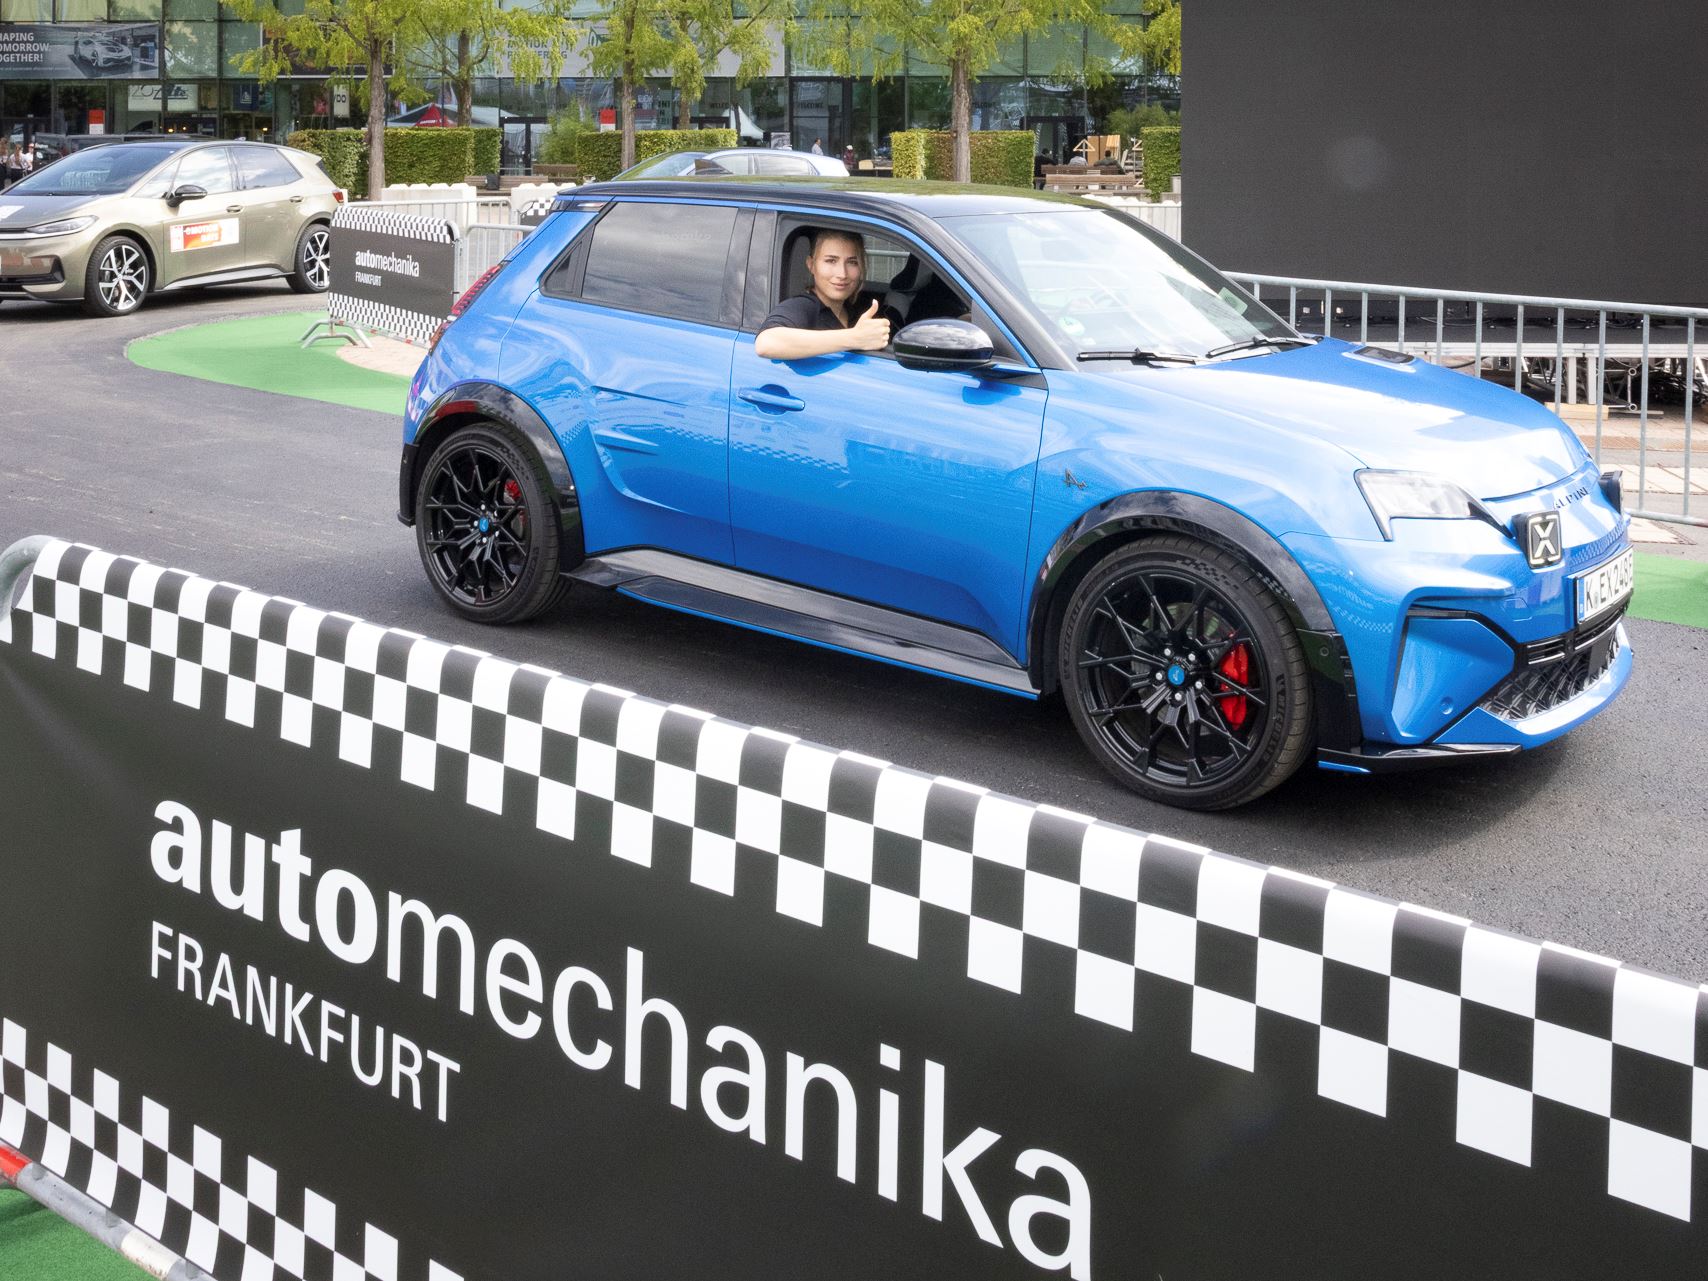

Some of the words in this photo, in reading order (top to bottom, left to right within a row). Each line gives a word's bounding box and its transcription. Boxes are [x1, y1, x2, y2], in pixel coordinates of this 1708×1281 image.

[355, 249, 420, 278] automechanika
[355, 271, 382, 287] FRANKFURT
[151, 920, 461, 1123] FRANKFURT
[151, 800, 1092, 1281] automechanika
